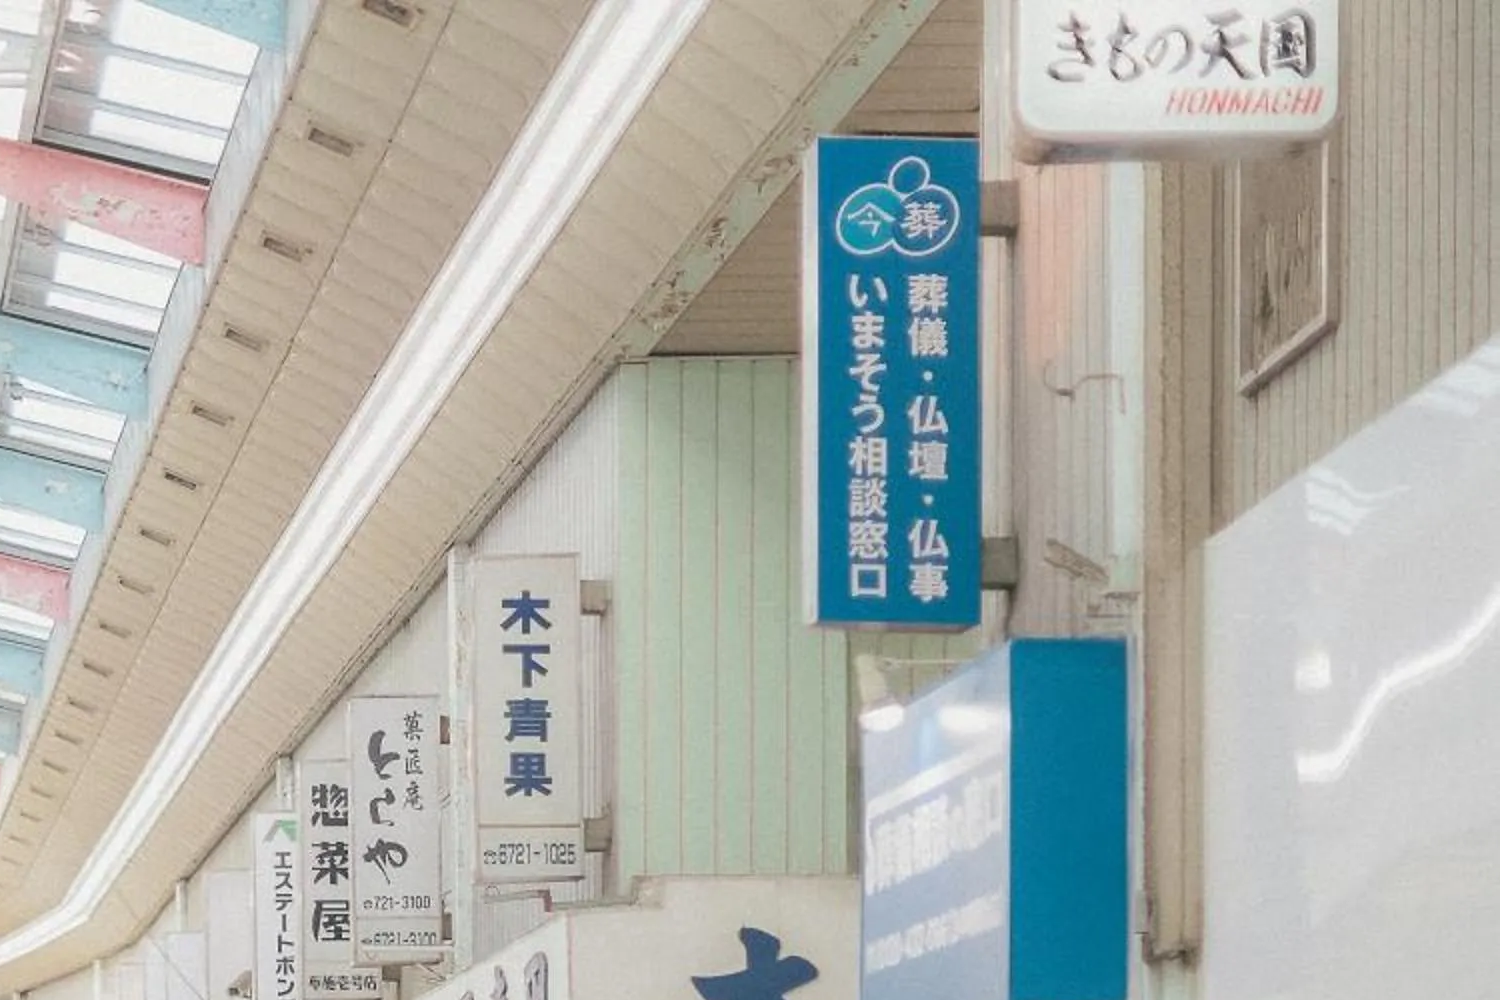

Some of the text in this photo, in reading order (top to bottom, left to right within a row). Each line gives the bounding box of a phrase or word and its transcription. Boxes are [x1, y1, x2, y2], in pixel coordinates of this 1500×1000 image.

[1165, 87, 1324, 116] HONMACHI
[848, 274, 888, 598] いまそう相談窓口
[907, 274, 949, 602] 葬儀・仏壇・仏事
[500, 590, 552, 797] 木下青果
